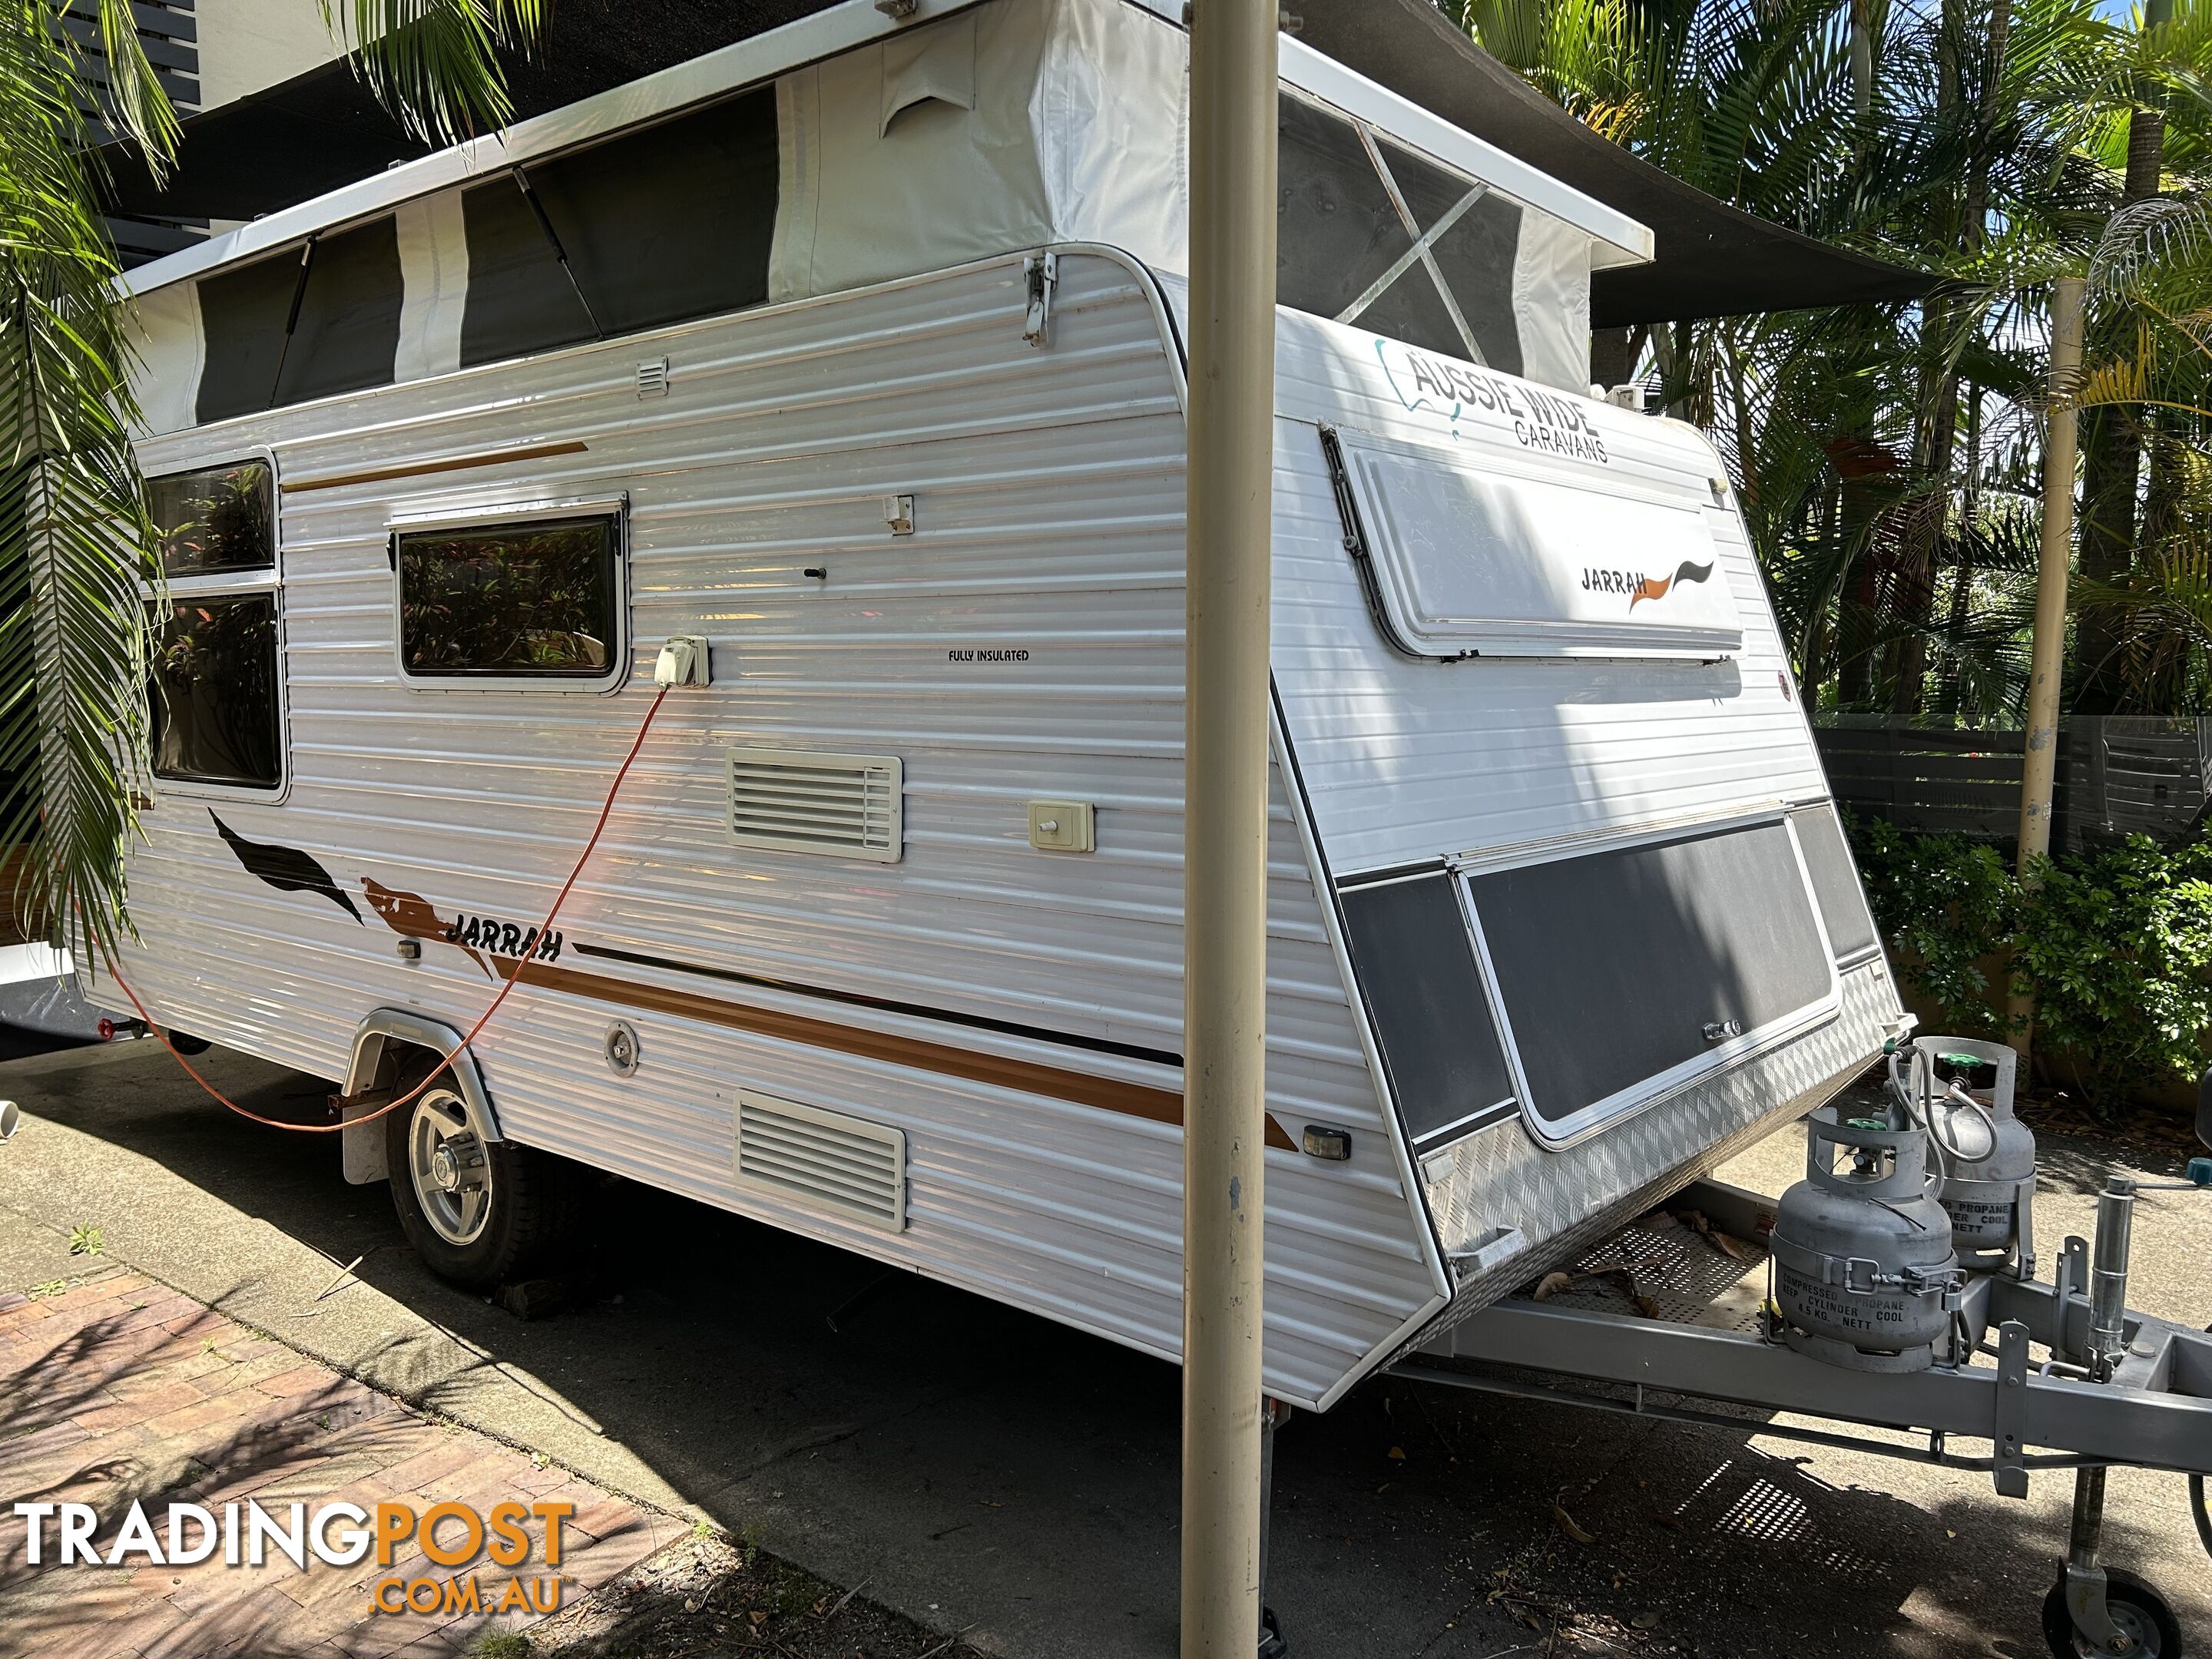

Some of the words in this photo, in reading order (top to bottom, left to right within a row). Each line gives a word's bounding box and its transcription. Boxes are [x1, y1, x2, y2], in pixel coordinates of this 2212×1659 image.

[1406, 352, 1525, 419] AUSSIE
[1512, 384, 1600, 438] WIDE
[1515, 420, 1608, 464] CARAVANS
[1582, 568, 1647, 594] JARRAH
[949, 650, 975, 662] FULLY
[977, 650, 1029, 662] INSULATED
[445, 914, 563, 962] JARRAH
[1959, 1204, 2010, 1214] PROPANE
[1982, 1215, 2008, 1224] COOL
[1952, 1222, 1983, 1233] NETT
[1783, 1273, 1838, 1301] COMPRESSED
[1855, 1298, 1904, 1310] PROPANE
[1783, 1283, 1799, 1299] KEEP
[1808, 1296, 1859, 1317] CYLINDER
[1876, 1311, 1903, 1322] COOL
[1843, 1316, 1872, 1330] NETT
